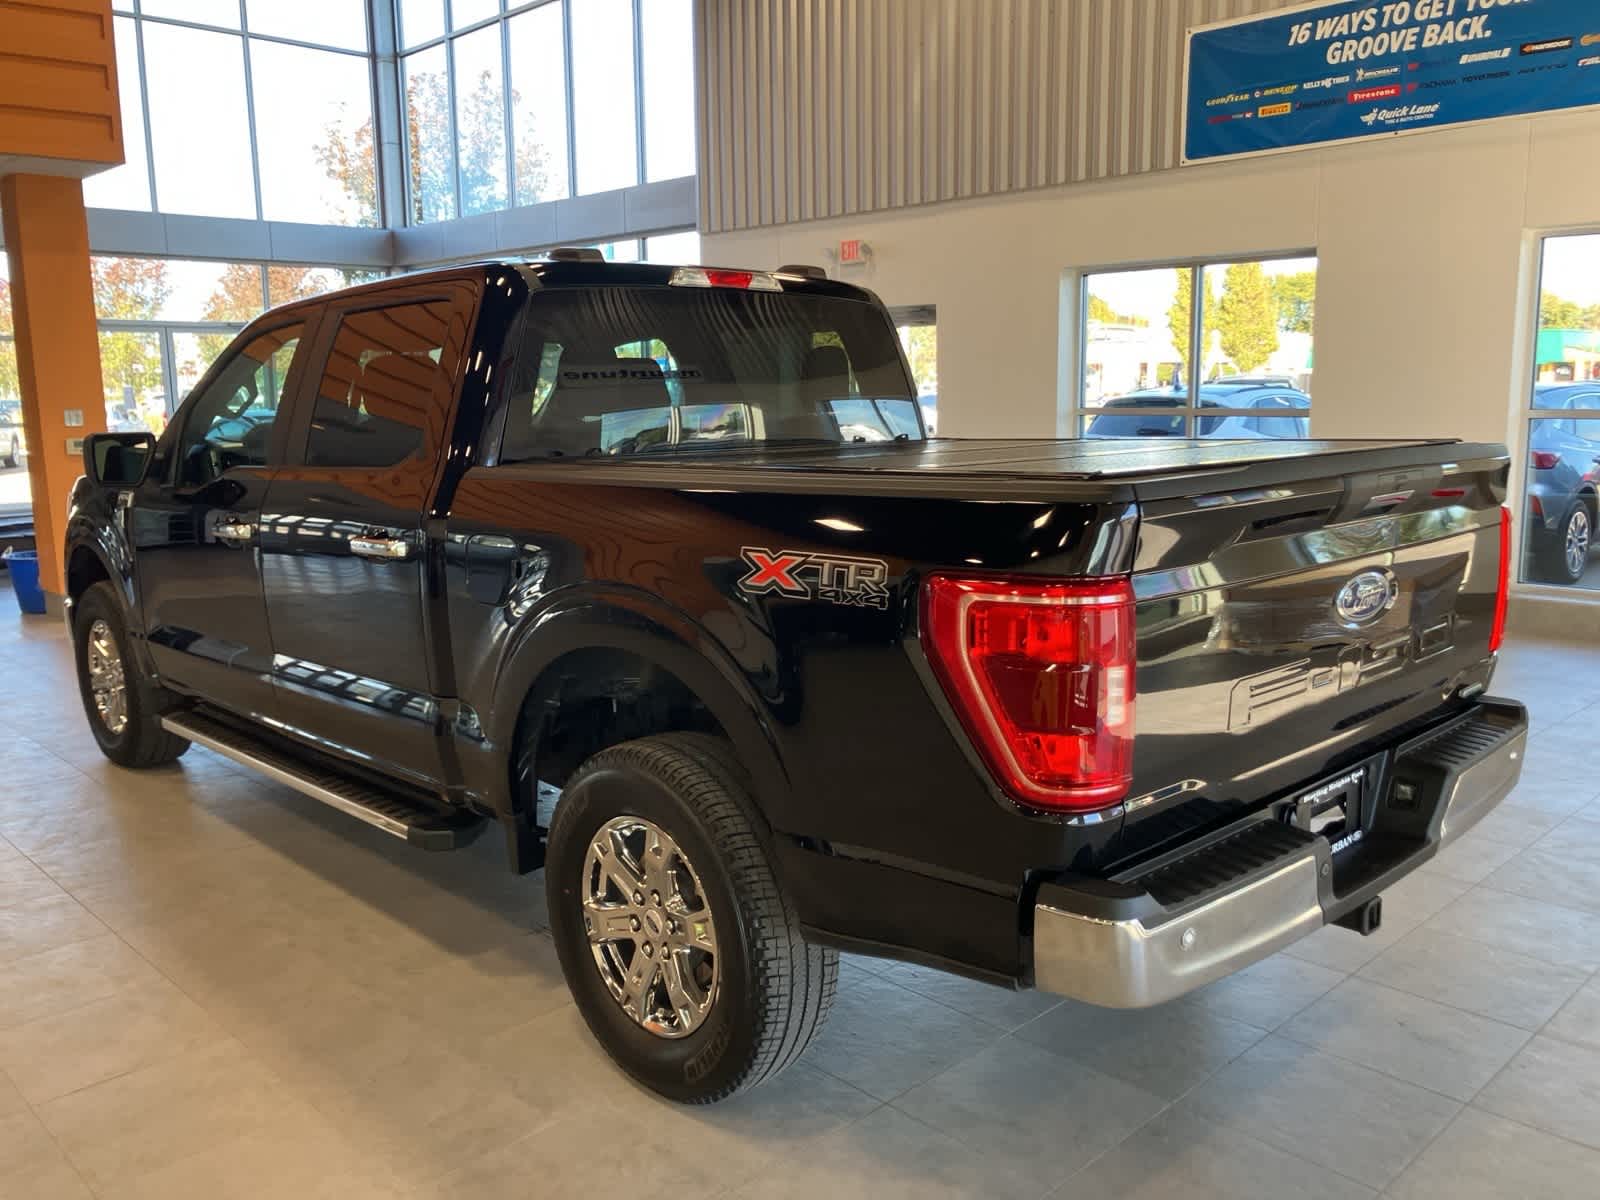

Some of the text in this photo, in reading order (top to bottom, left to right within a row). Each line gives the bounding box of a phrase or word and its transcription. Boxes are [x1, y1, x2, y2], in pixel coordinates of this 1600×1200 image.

[1287, 22, 1312, 46] 16
[1315, 8, 1378, 41] WAYS
[1381, 1, 1410, 28] TO
[1414, 0, 1456, 21] GET
[1326, 26, 1420, 65] GROOVE
[1421, 14, 1492, 48] BACK.
[1377, 101, 1440, 121] Quick Lane
